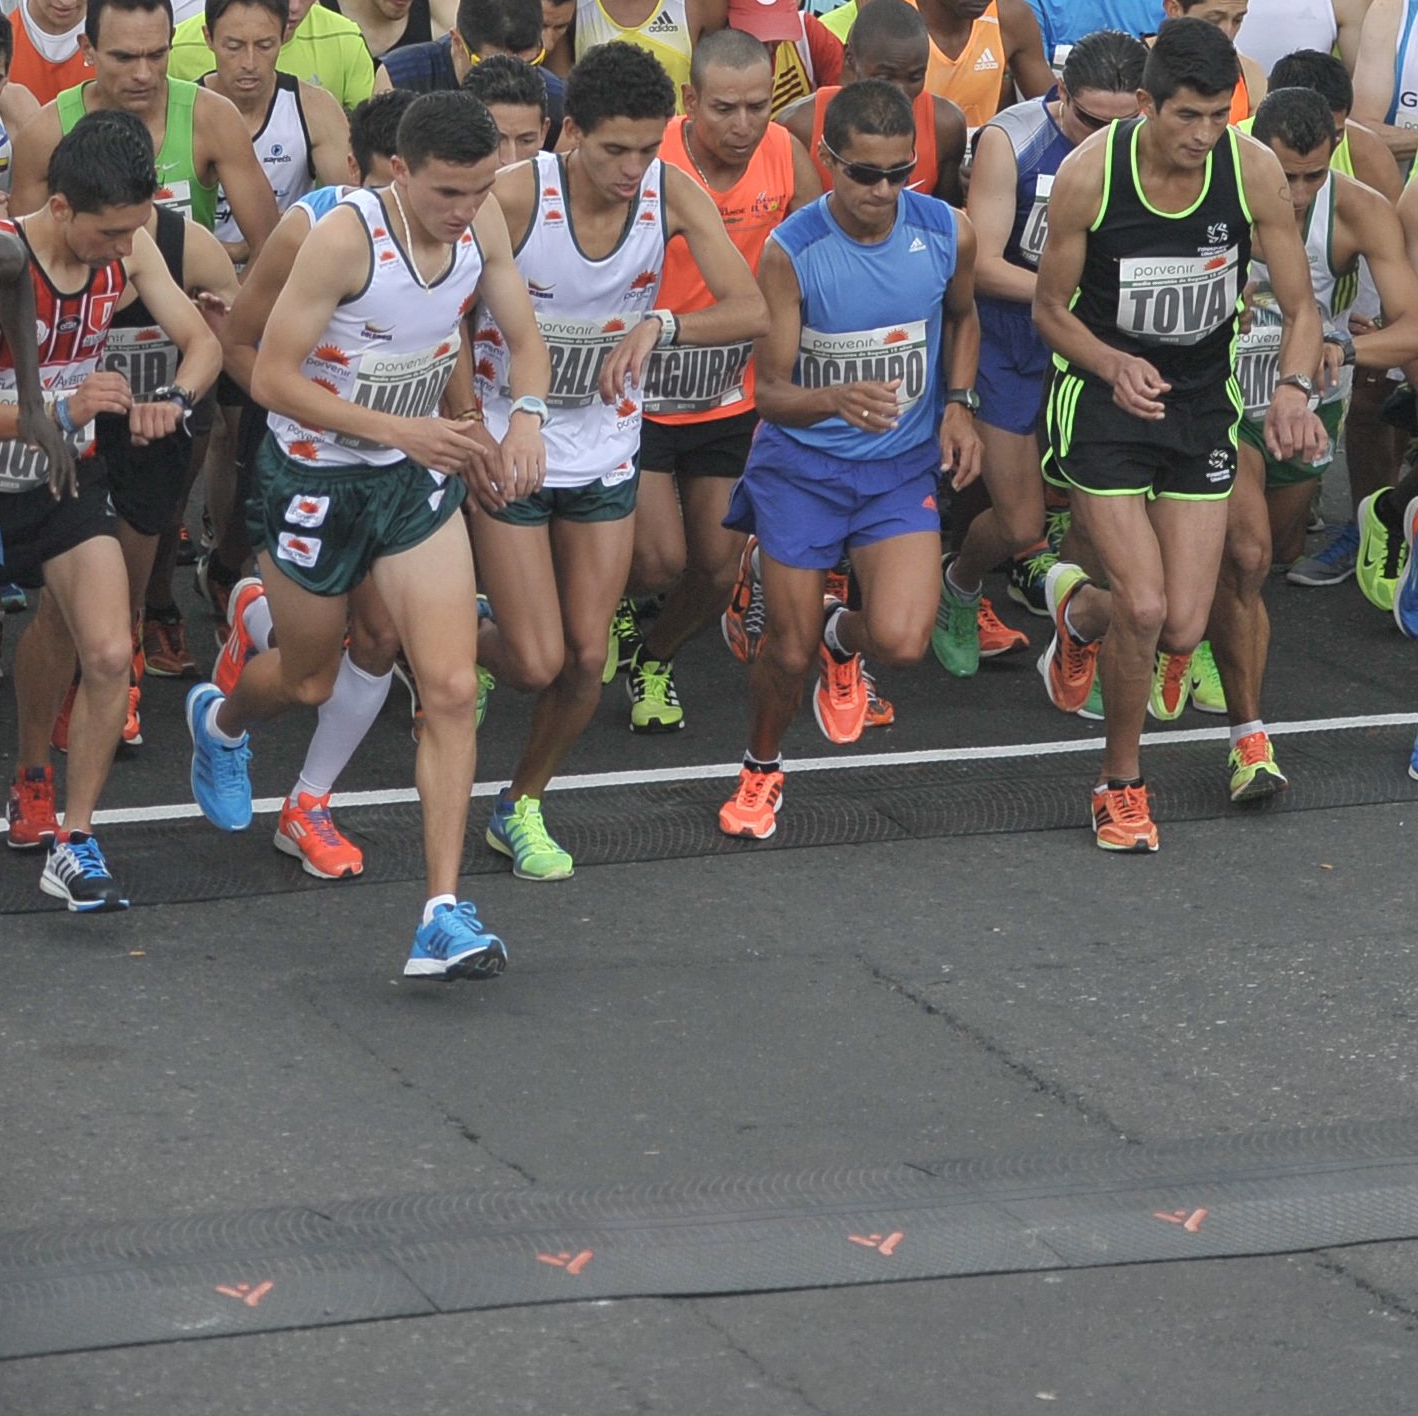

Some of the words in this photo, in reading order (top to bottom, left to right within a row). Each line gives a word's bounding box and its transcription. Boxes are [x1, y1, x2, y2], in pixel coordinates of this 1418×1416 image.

[649, 22, 678, 32] adidas
[974, 62, 999, 71] adidas
[1134, 265, 1195, 279] porvenir
[1129, 276, 1227, 333] TOVA
[813, 337, 874, 350] porvenir
[306, 356, 351, 377] porvenir
[373, 355, 429, 374] porvenir
[644, 344, 753, 399] AGUIRRE
